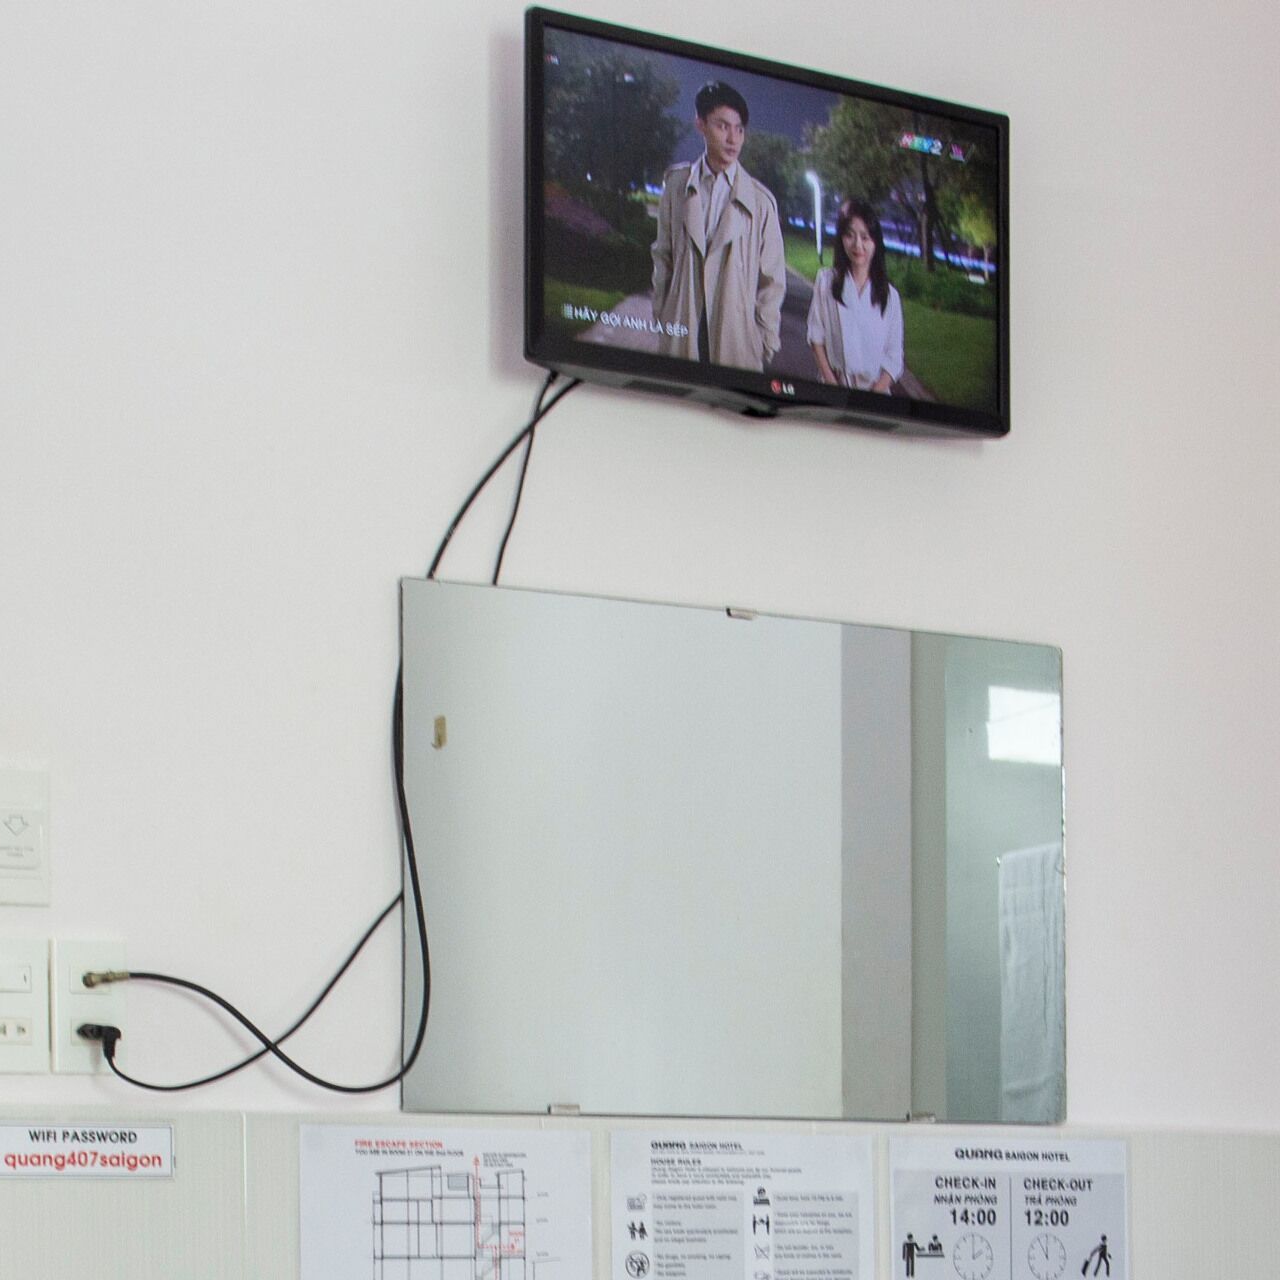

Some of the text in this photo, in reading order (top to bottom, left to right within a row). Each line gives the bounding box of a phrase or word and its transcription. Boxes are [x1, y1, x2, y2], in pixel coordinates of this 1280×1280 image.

[622, 314, 648, 332] ANH
[28, 1129, 138, 1144] WIFI PASSWORD
[3, 1151, 163, 1171] quang407saigon
[1005, 1151, 1039, 1161] SAIGON
[1041, 1152, 1071, 1162] HOTEL
[934, 1175, 997, 1190] CHECK-IN
[1023, 1177, 1093, 1192] CHECK-OUT
[950, 1208, 997, 1226] 14:00
[1025, 1208, 1069, 1226] 12:00
